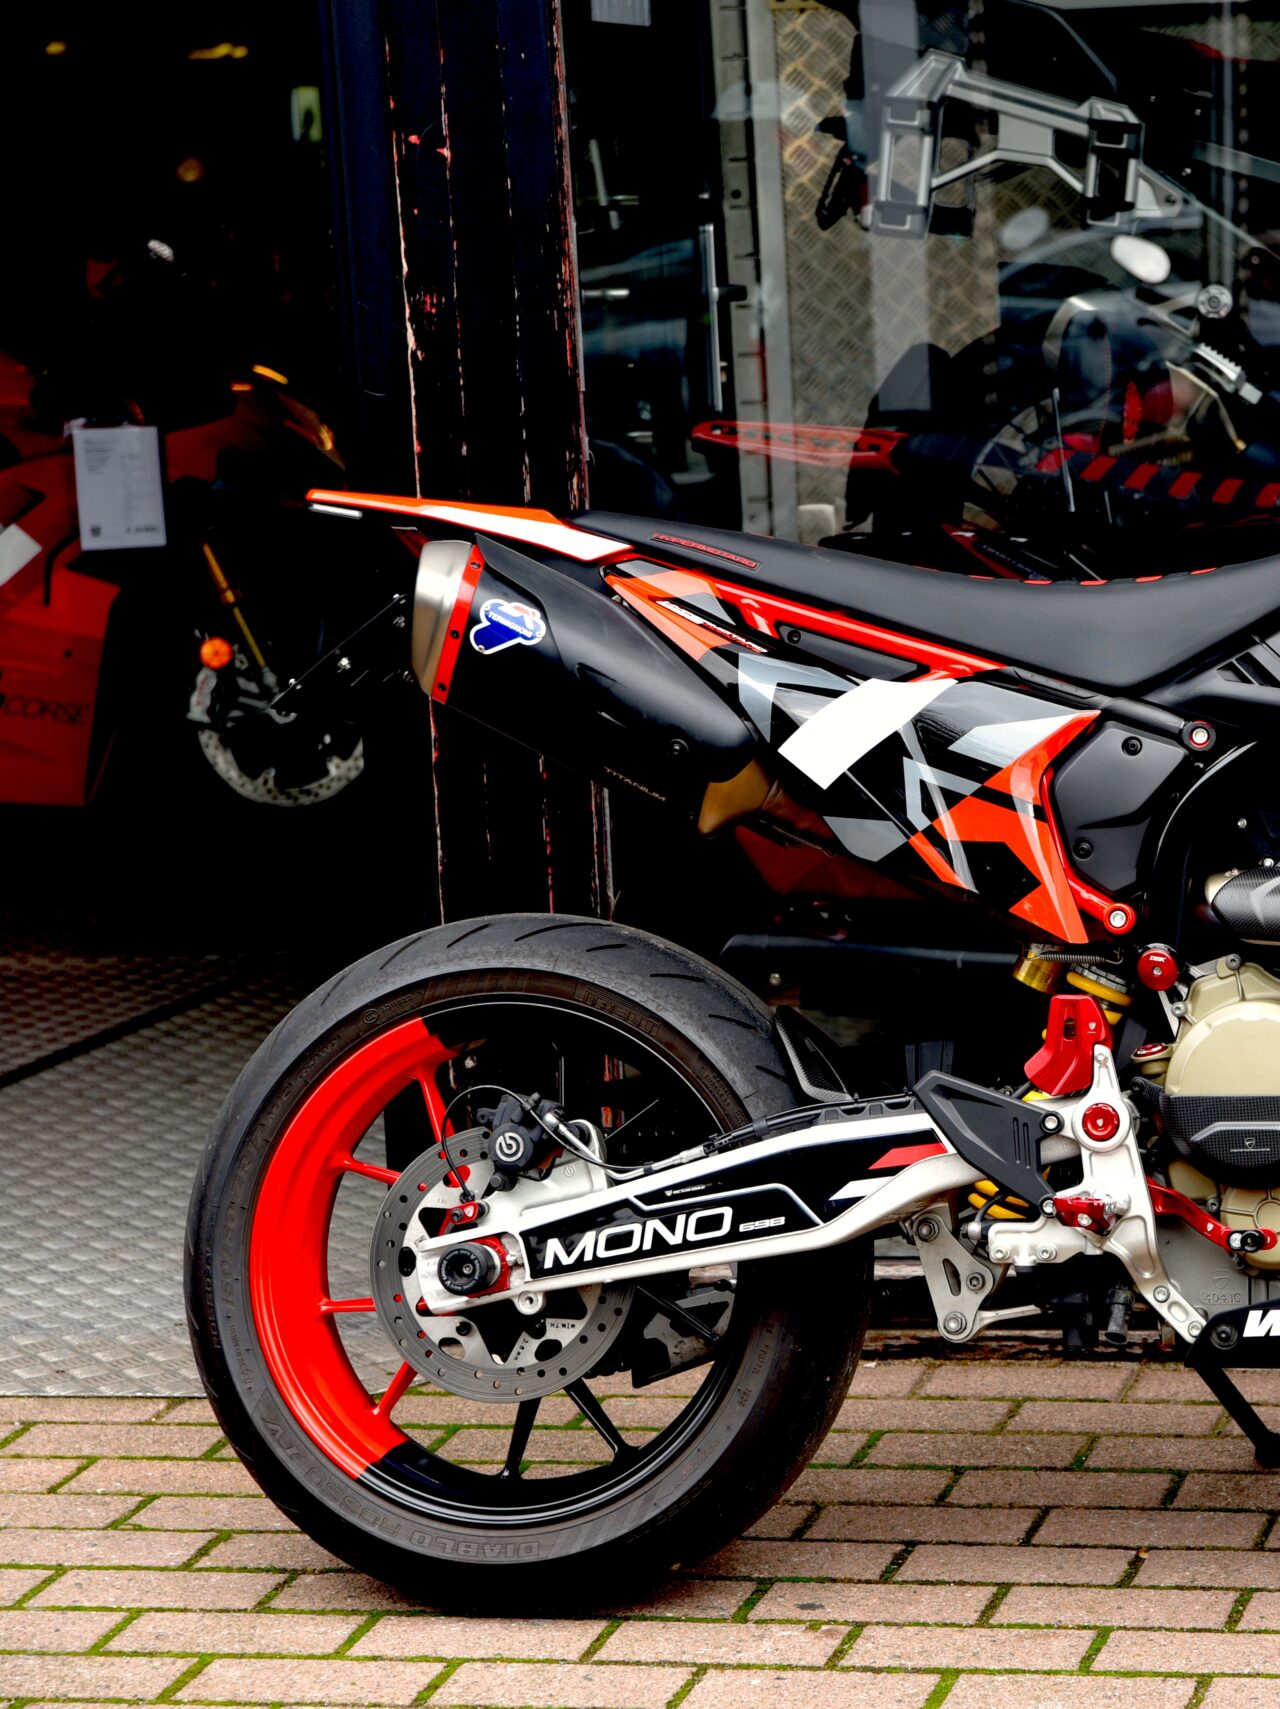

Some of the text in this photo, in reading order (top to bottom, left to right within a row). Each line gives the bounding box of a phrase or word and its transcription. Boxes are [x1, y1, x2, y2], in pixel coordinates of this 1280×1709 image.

[488, 611, 534, 638] TERMIGNONI
[604, 766, 666, 801] TITANIUM
[544, 1206, 786, 1269] MONO 698
[1205, 1293, 1241, 1304] 404.1C
[305, 1466, 400, 1537] ROSSO
[410, 1531, 540, 1559] DIABLO
